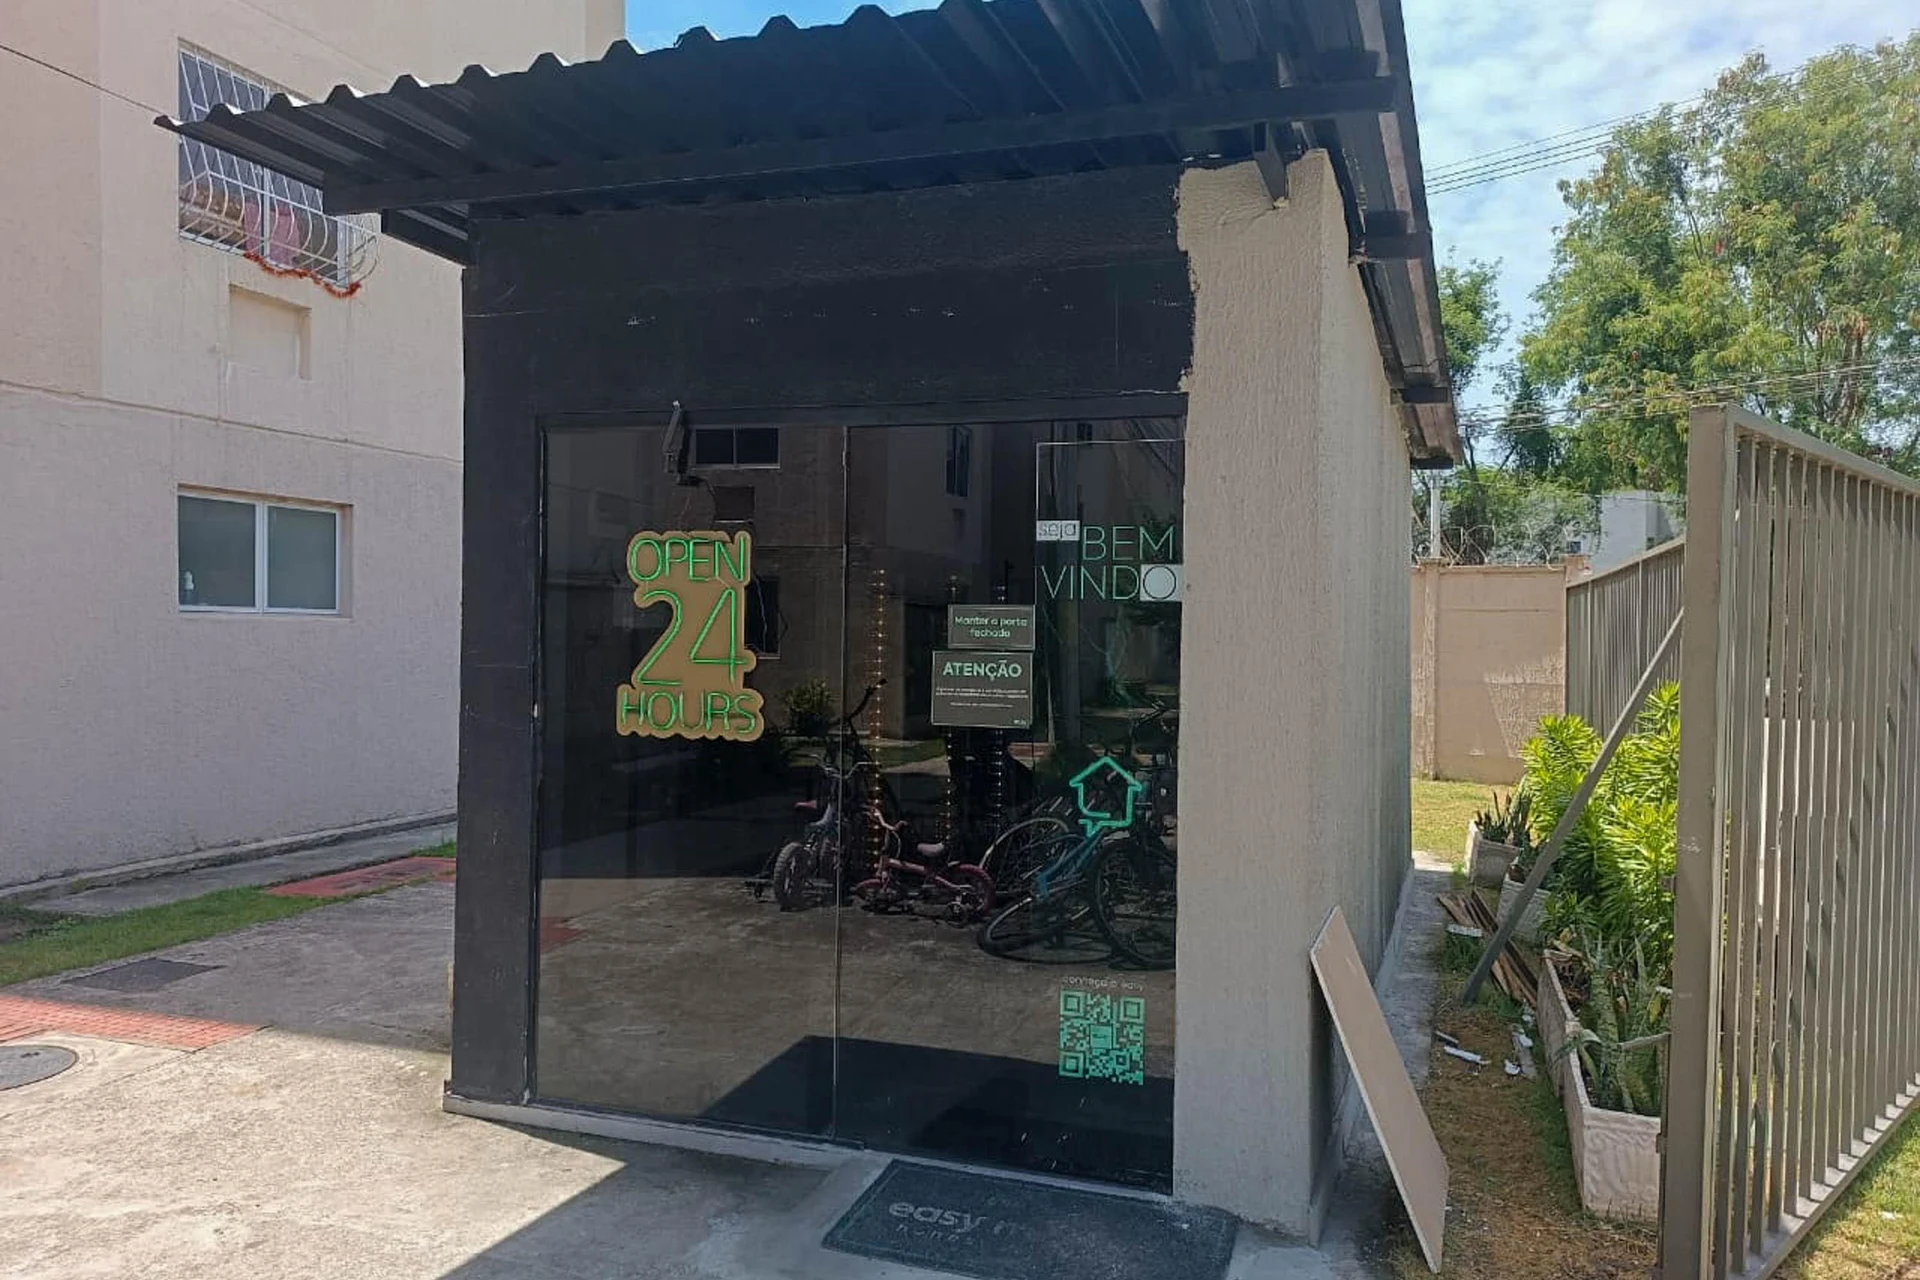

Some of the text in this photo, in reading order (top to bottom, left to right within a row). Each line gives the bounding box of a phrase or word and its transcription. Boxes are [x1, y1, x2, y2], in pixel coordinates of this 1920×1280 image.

[631, 535, 745, 582] OPEN
[1083, 525, 1175, 561] BEM
[1040, 564, 1177, 601] VINDO
[637, 588, 748, 686] 24
[955, 616, 1028, 628] Manter a porta
[971, 628, 1011, 638] fechada
[942, 659, 1023, 682] ATENÇÃO
[621, 691, 756, 735] HOURS
[889, 1202, 988, 1234] easy
